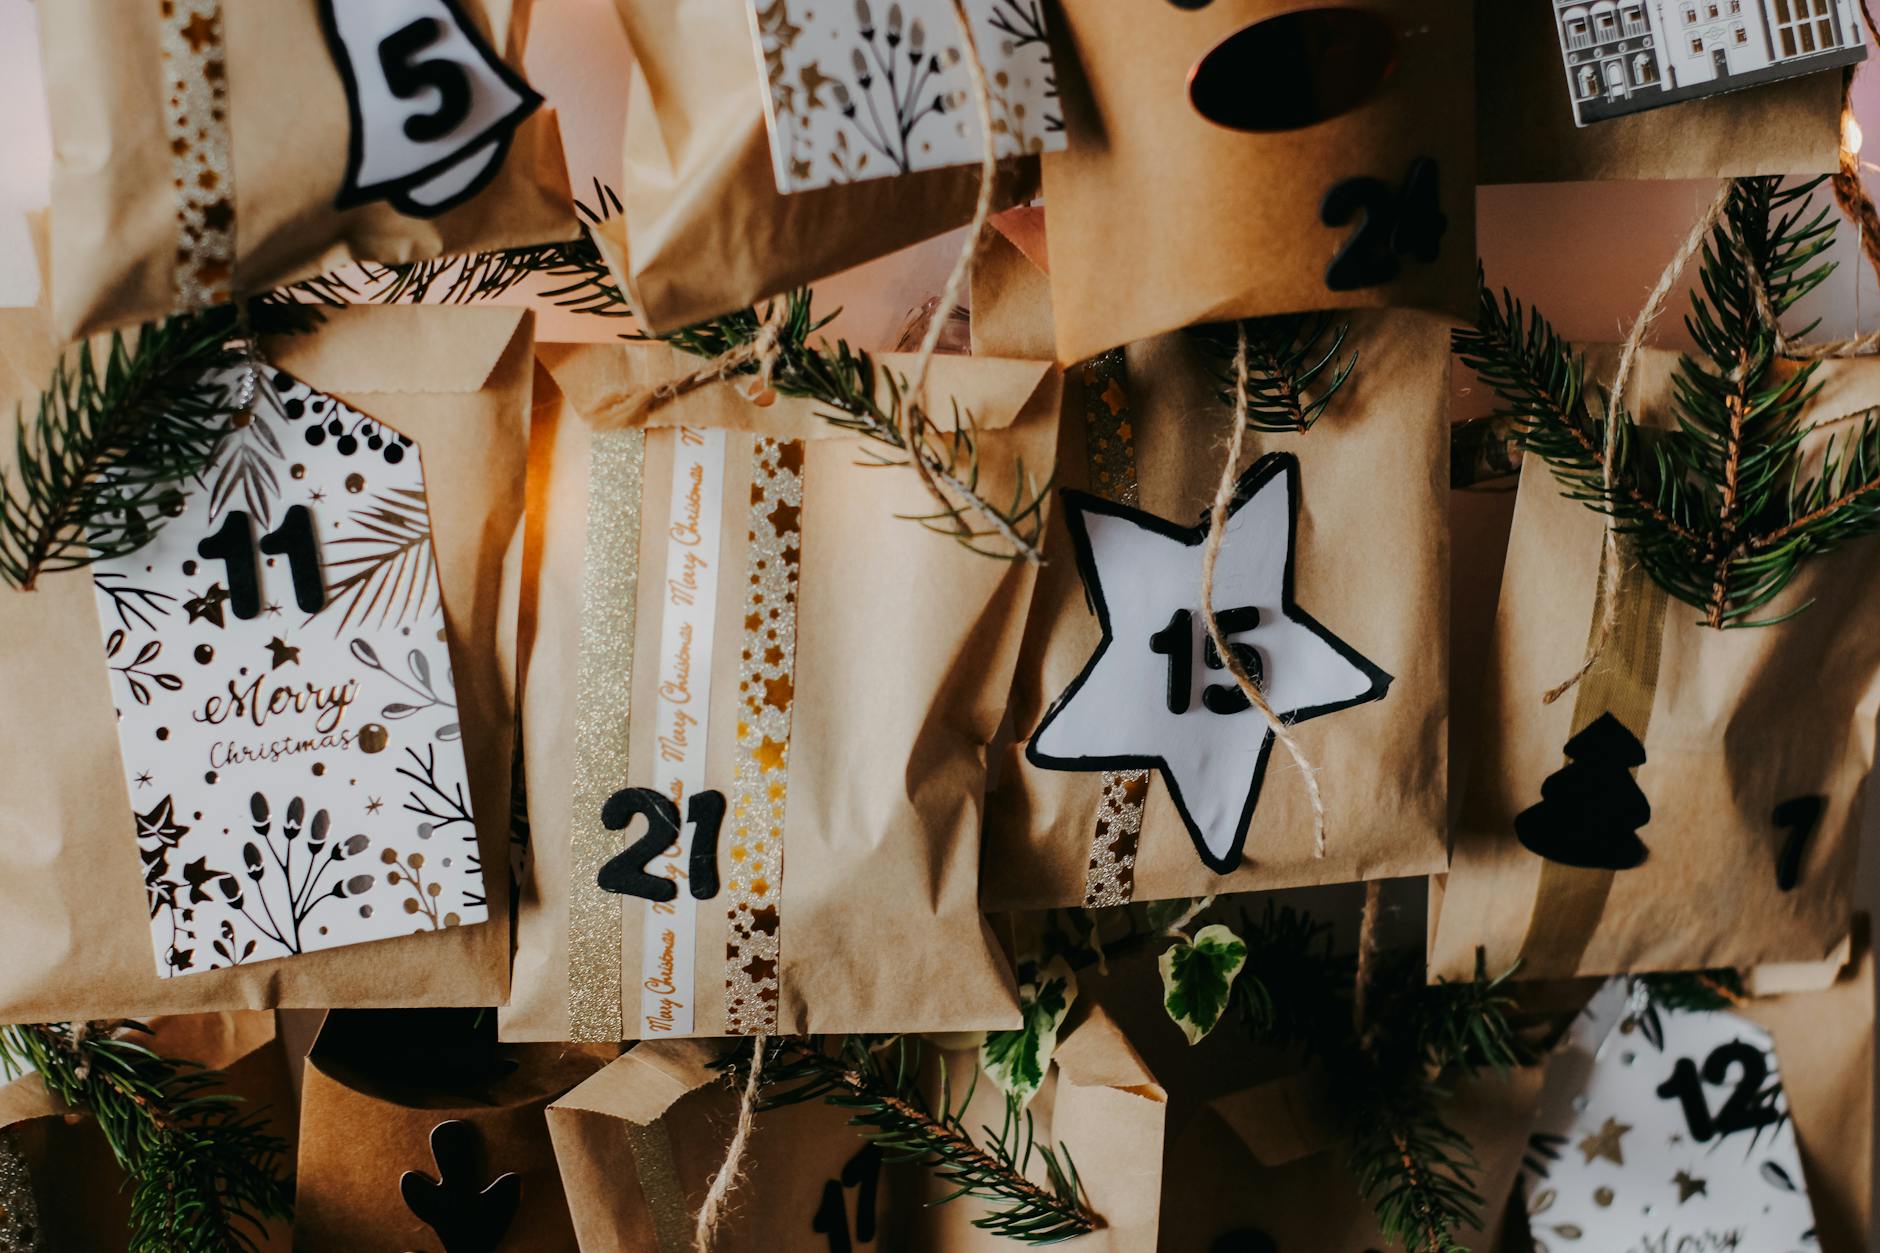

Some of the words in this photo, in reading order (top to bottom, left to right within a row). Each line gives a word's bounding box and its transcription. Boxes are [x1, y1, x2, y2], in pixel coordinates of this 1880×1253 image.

[378, 17, 471, 143] 5
[1320, 157, 1447, 291] 24
[197, 504, 326, 620] 11
[193, 674, 361, 734] Merry
[1150, 606, 1263, 714] 15
[210, 729, 359, 768] Christmas
[598, 786, 726, 902] 21
[1773, 795, 1824, 891] 7
[644, 928, 677, 995] Christmas
[1656, 1038, 1779, 1142] 12
